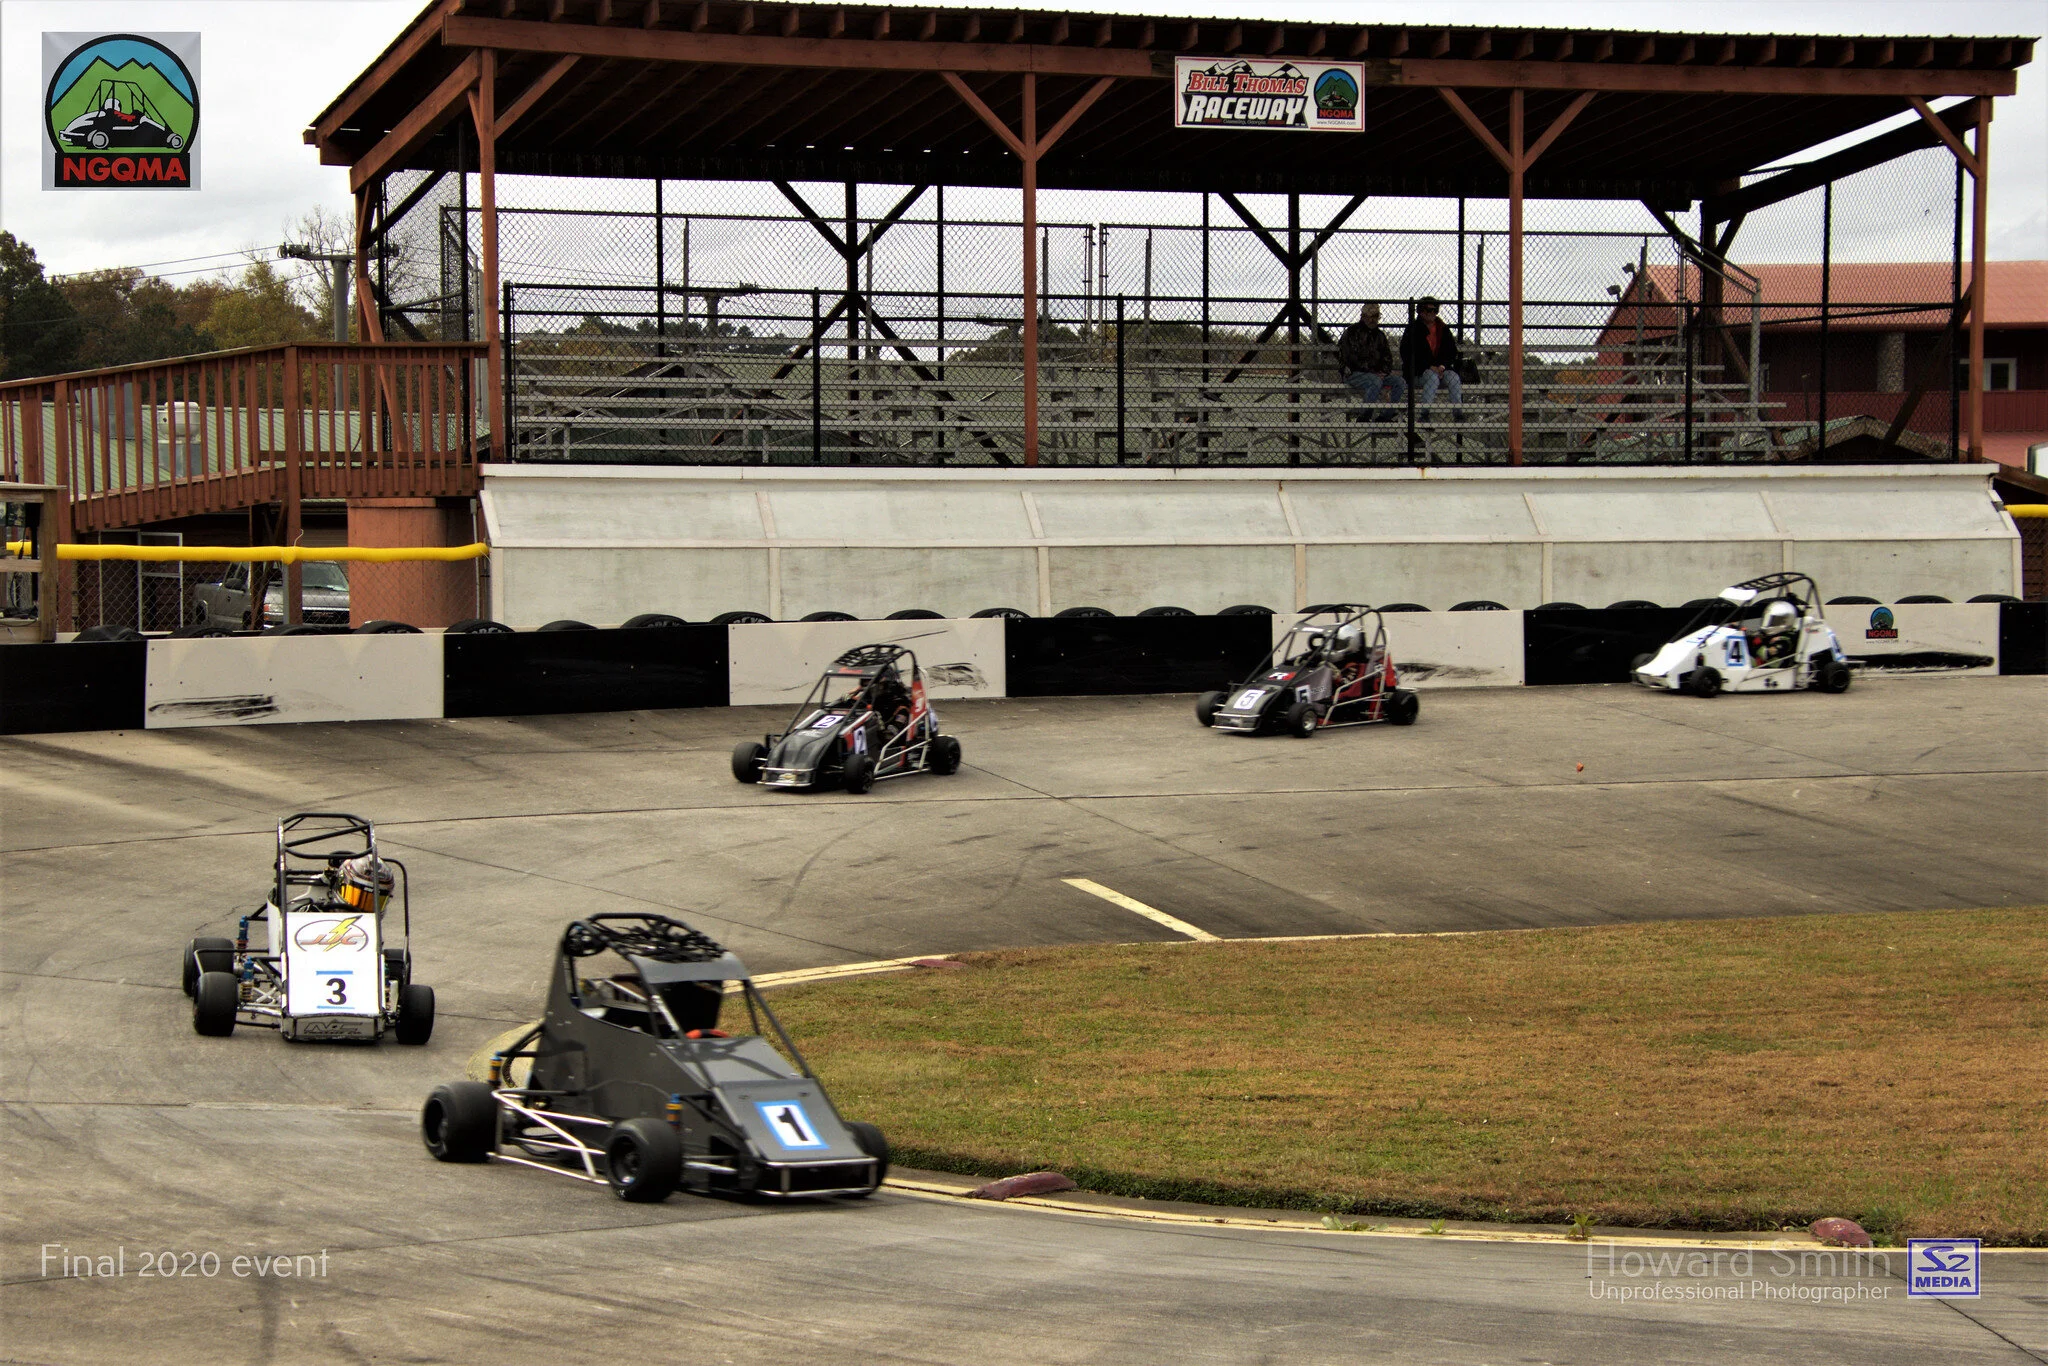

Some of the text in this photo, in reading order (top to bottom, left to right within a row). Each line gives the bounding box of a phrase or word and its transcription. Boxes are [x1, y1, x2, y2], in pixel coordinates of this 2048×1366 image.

[1186, 95, 1305, 125] RACEWAY
[1319, 109, 1354, 118] NGQMA
[1729, 640, 1741, 662] 4
[1241, 692, 1258, 706] 5
[818, 717, 836, 726] 2
[326, 978, 347, 1005] 3
[777, 1107, 809, 1141] 1
